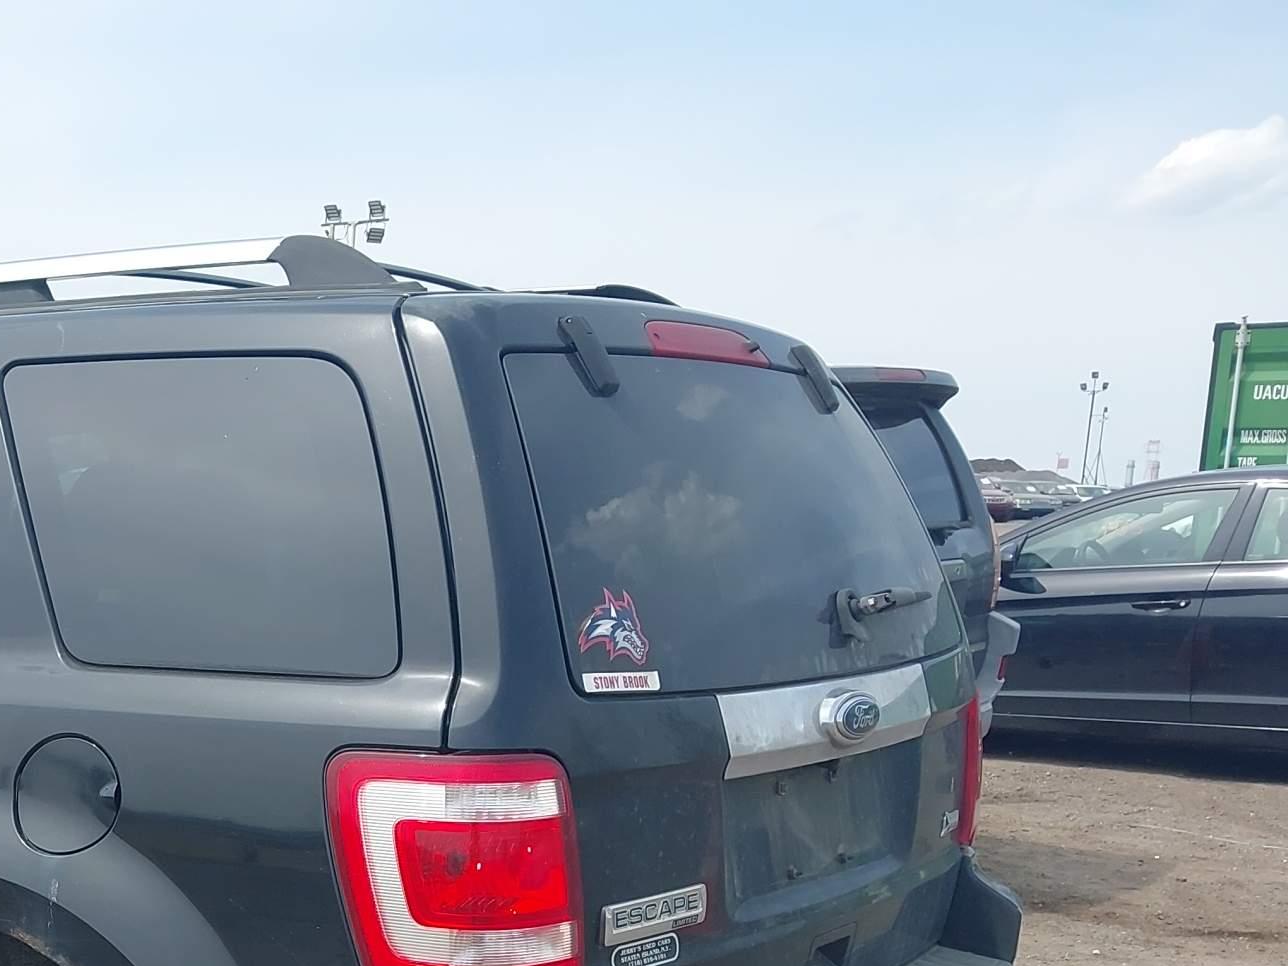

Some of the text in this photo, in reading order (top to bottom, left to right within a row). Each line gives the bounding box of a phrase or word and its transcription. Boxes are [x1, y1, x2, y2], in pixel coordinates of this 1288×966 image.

[593, 675, 650, 689] STONY BROOK
[853, 704, 877, 729] Ford
[615, 893, 699, 929] ESCAPE
[642, 942, 657, 950] USED
